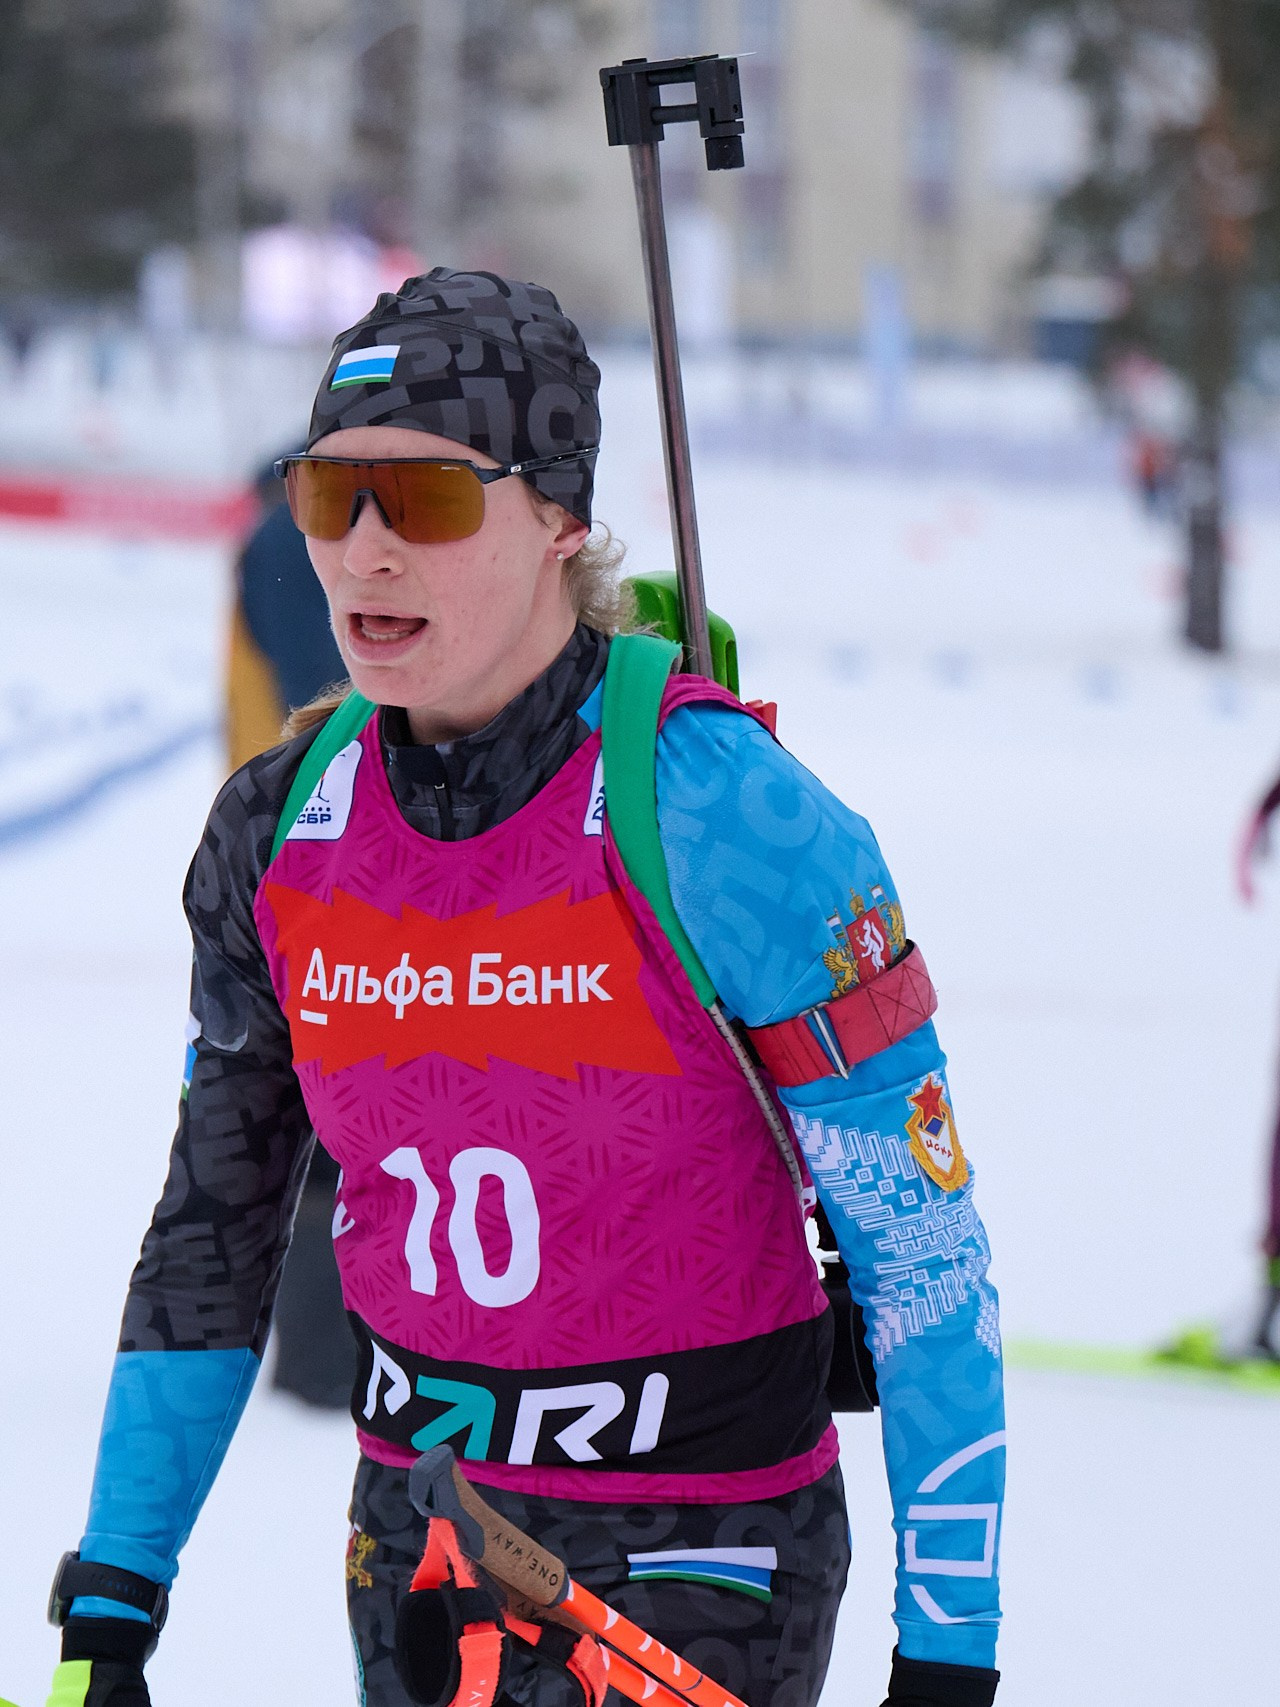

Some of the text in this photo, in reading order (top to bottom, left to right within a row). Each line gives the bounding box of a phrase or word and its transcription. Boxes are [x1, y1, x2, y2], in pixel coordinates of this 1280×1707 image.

[300, 947, 613, 1025] Альфа Банк
[379, 1147, 541, 1308] 10
[362, 1339, 670, 1465] PARI
